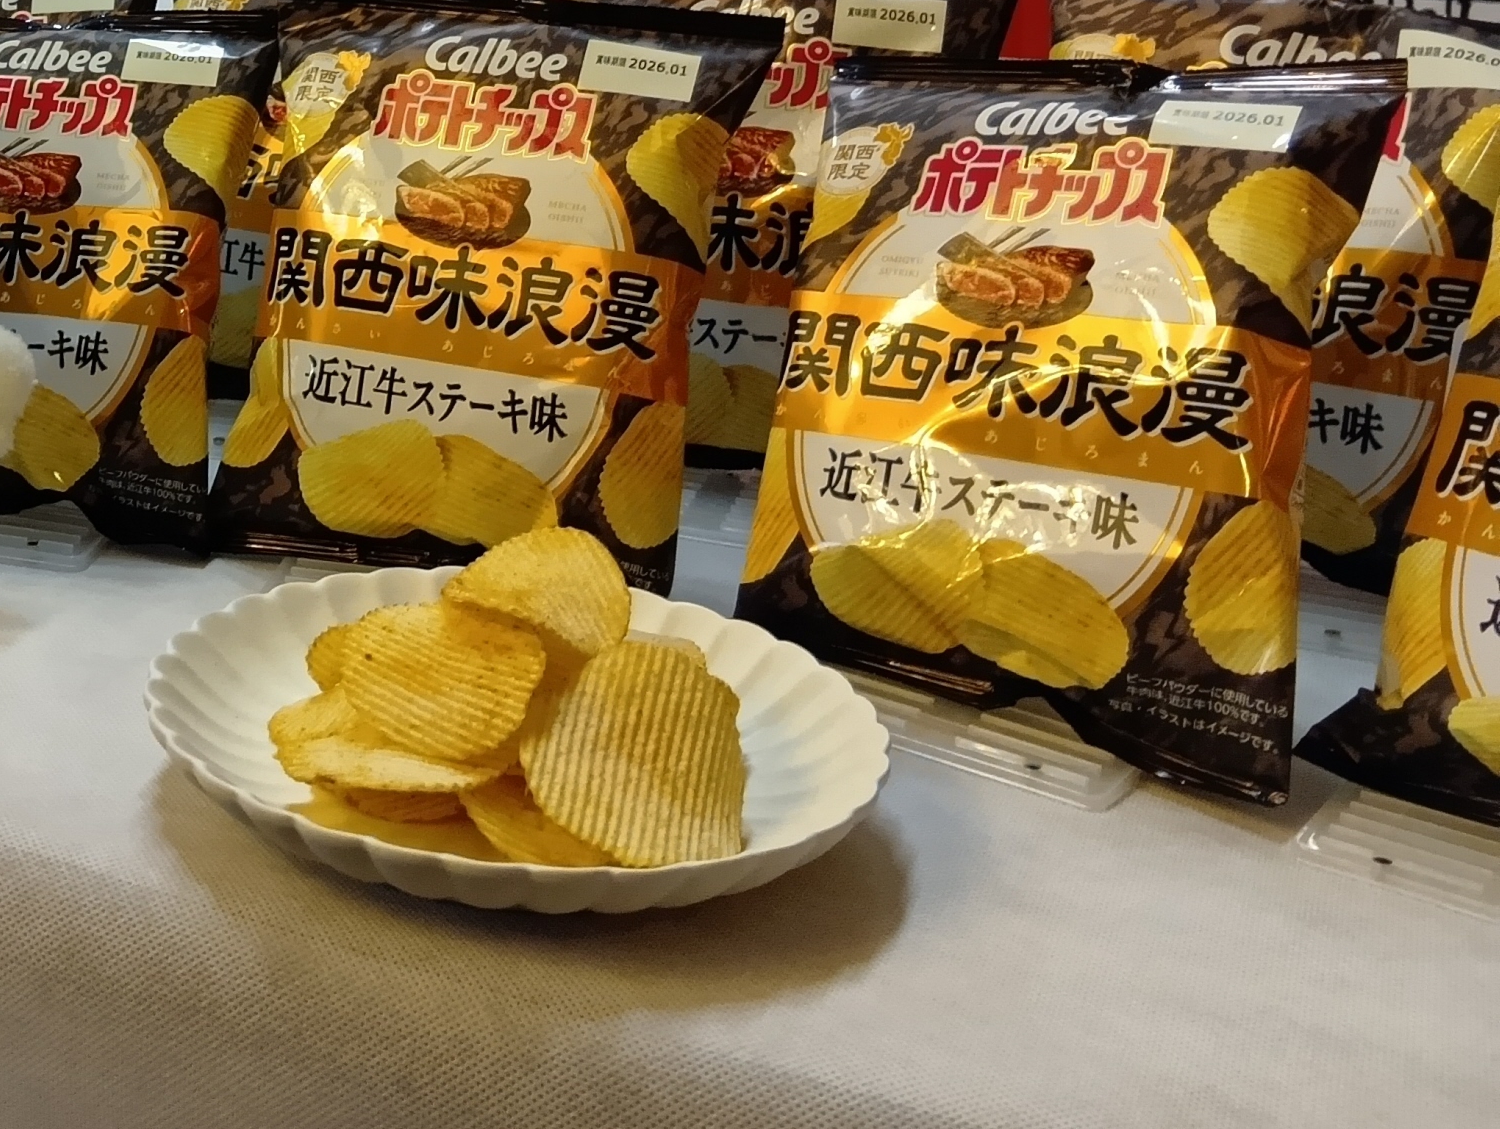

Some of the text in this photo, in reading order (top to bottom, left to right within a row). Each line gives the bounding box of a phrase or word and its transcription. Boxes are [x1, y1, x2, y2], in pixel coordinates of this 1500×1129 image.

[879, 8, 937, 25] 2026.01
[425, 36, 568, 81] Calbee
[629, 58, 688, 76] 2026.01
[373, 74, 595, 159] ポテトチップス
[974, 101, 1138, 137] Calbee
[1212, 109, 1285, 128] 2026.01
[827, 163, 871, 180] 限定
[833, 144, 878, 161] 関西
[912, 139, 1169, 224] ポテトチップス
[268, 227, 660, 361] 関西味浪漫
[11, 329, 109, 376] ーキ味
[689, 318, 787, 355] ステー
[301, 353, 569, 443] 近江牛ステーキ味
[778, 310, 1252, 453] 関西味浪漫
